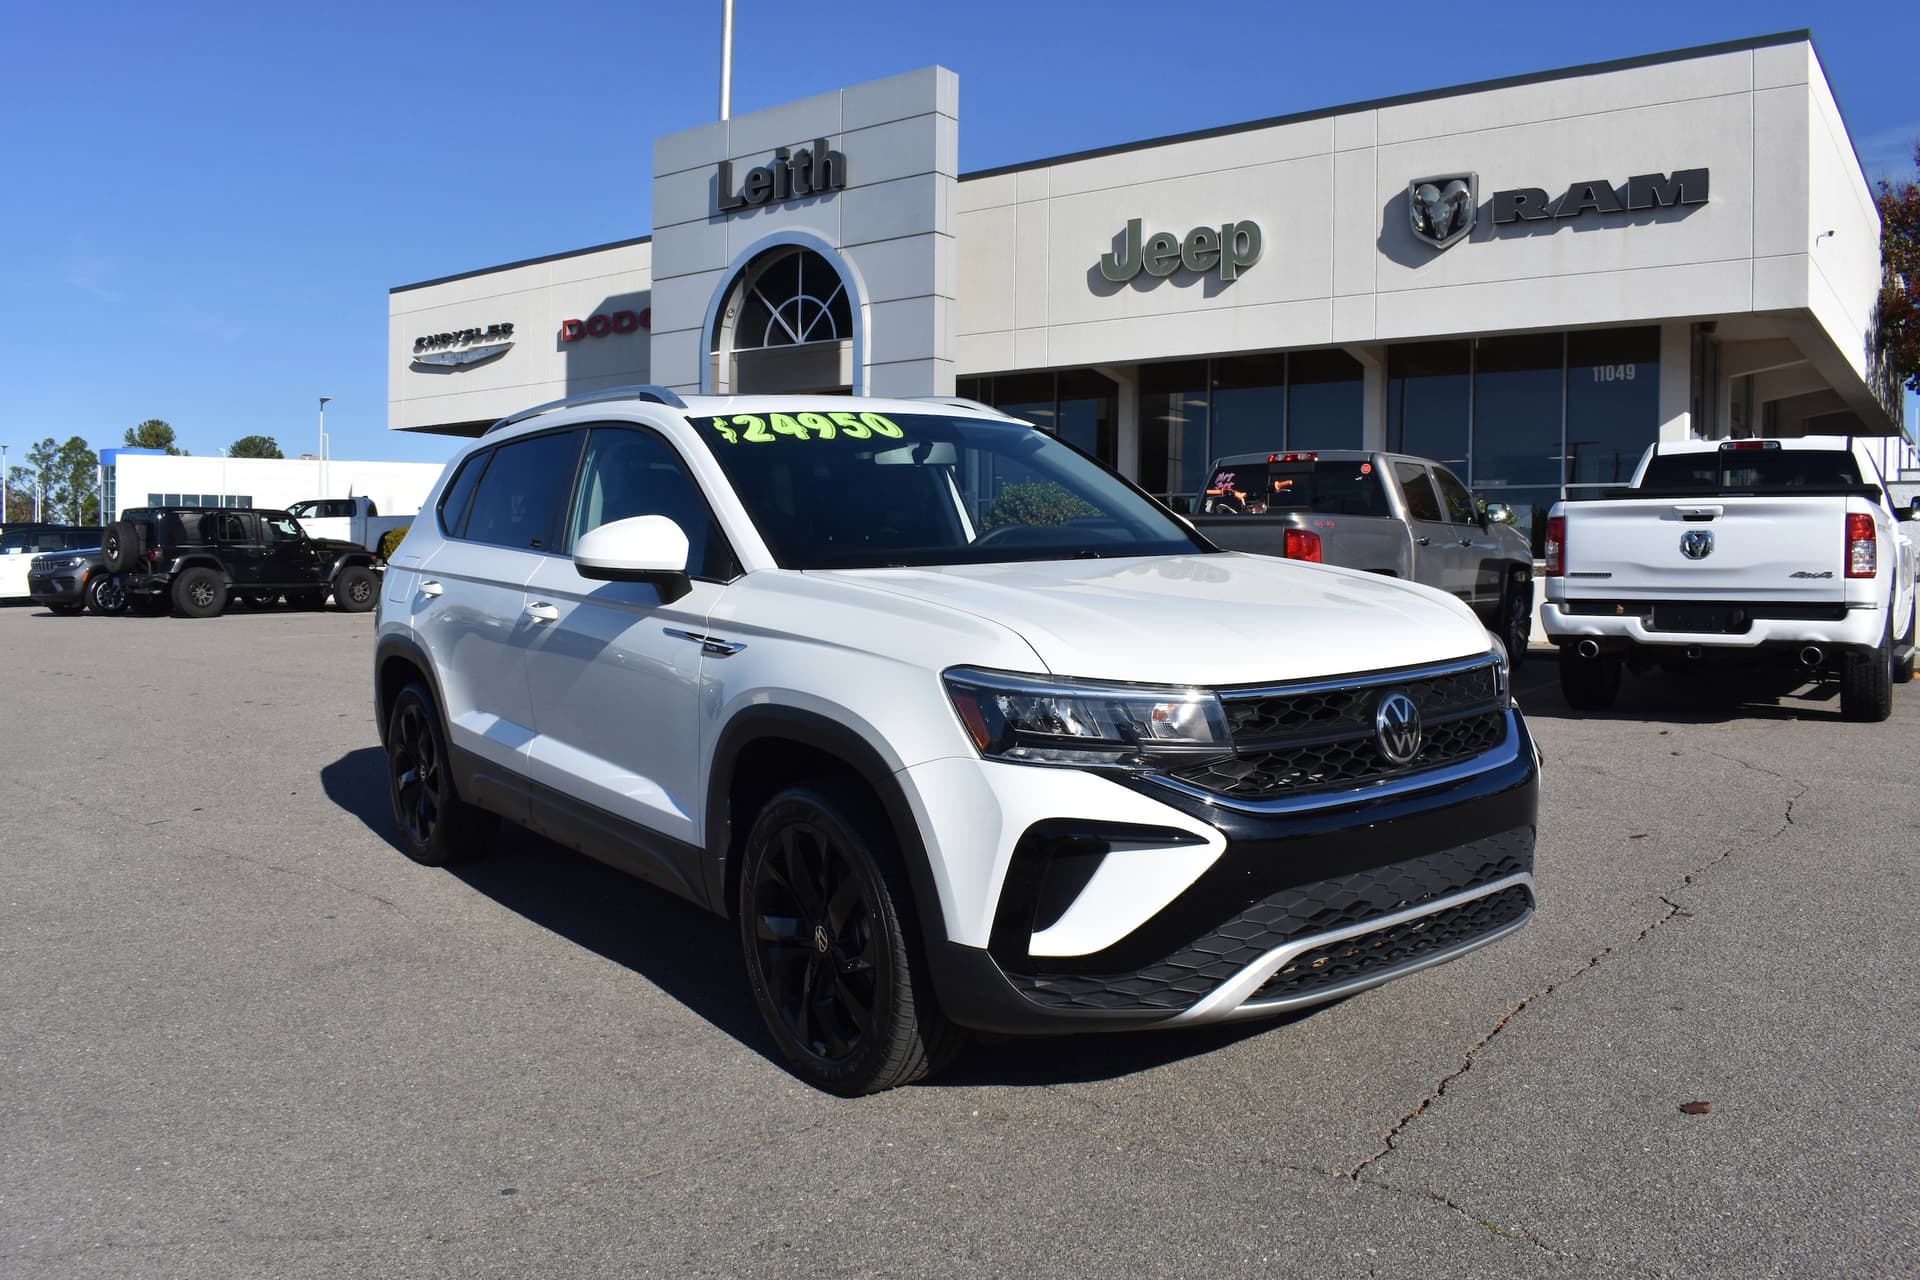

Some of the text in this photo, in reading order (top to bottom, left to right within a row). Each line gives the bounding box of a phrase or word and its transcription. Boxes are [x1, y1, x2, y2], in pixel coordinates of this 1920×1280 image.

[717, 137, 847, 211] Leith
[1492, 167, 1710, 225] RAM
[1100, 217, 1263, 282] Jeep
[414, 322, 515, 349] CHRYSLER
[1592, 363, 1636, 382] 11049
[712, 411, 905, 445] $24950
